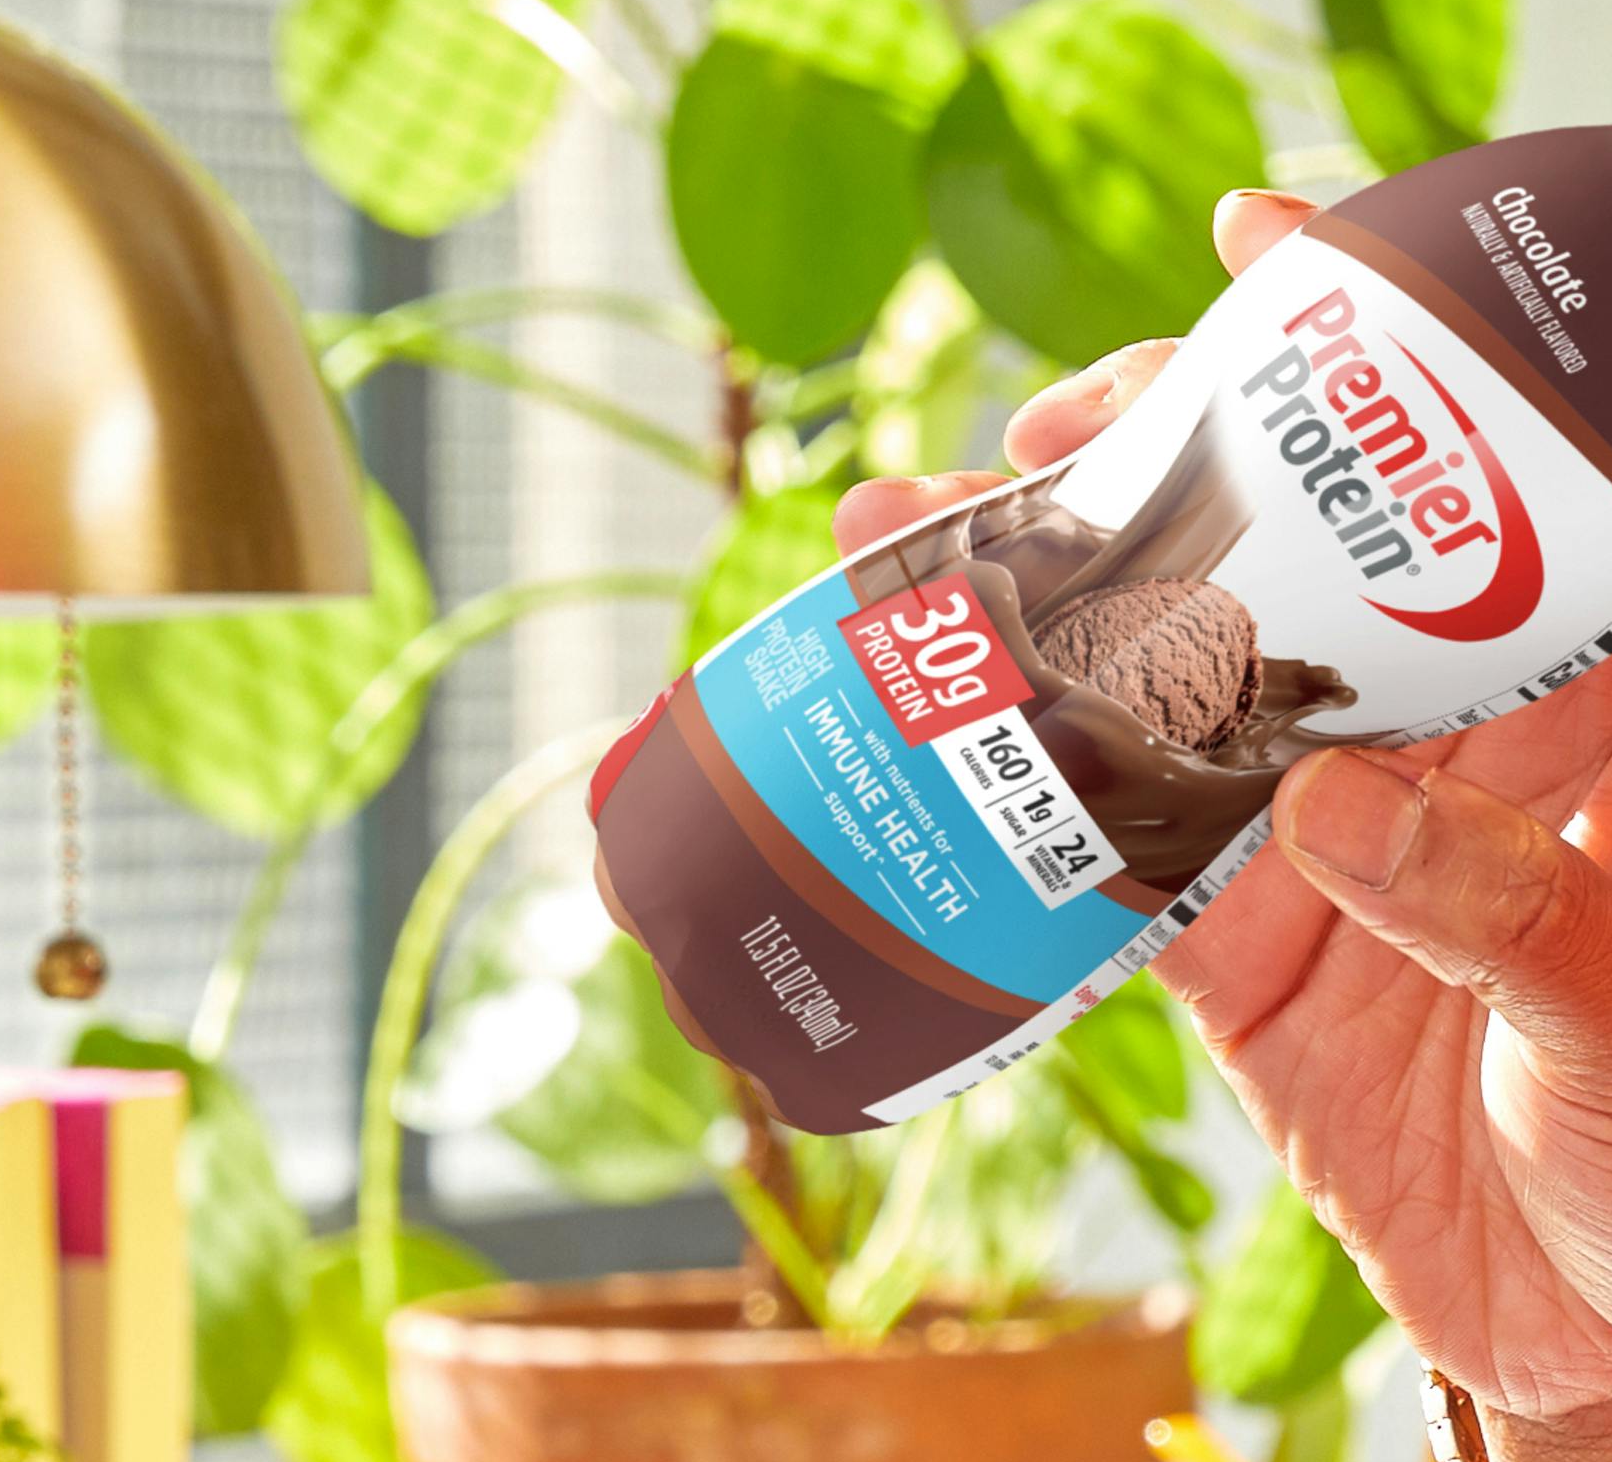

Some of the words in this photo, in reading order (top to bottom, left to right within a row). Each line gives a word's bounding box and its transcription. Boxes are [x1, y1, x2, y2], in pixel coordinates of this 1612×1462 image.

[1460, 202, 1510, 253] NATURALLY
[1492, 187, 1587, 314] Chocolate
[1491, 250, 1513, 264] &
[1497, 260, 1553, 324] ARTIFICIALLY
[1537, 318, 1587, 374] FLAVORED
[1282, 287, 1498, 556] Premier
[760, 616, 812, 697] PROTEIN
[793, 626, 835, 680] HIGH
[856, 620, 934, 723] PROTEIN
[891, 591, 991, 707] 30g
[744, 648, 789, 712] SHAKE
[960, 747, 994, 790] CALORIES
[978, 725, 1033, 781] 160
[803, 697, 889, 813] IMMUNE
[875, 808, 968, 923] HEALTH
[863, 729, 891, 766] with
[884, 751, 936, 831] nutrients
[929, 829, 953, 856] for
[1023, 790, 1056, 823] 1g
[999, 807, 1027, 838] SUGAR
[1025, 854, 1062, 893] MINERALS
[1034, 845, 1067, 887] VITAMINS
[1060, 881, 1072, 890] &
[1051, 833, 1098, 874] 24
[740, 915, 791, 961] 11.5
[759, 946, 802, 981] FL
[772, 965, 818, 1001] OZ
[779, 984, 859, 1053] (340mL)
